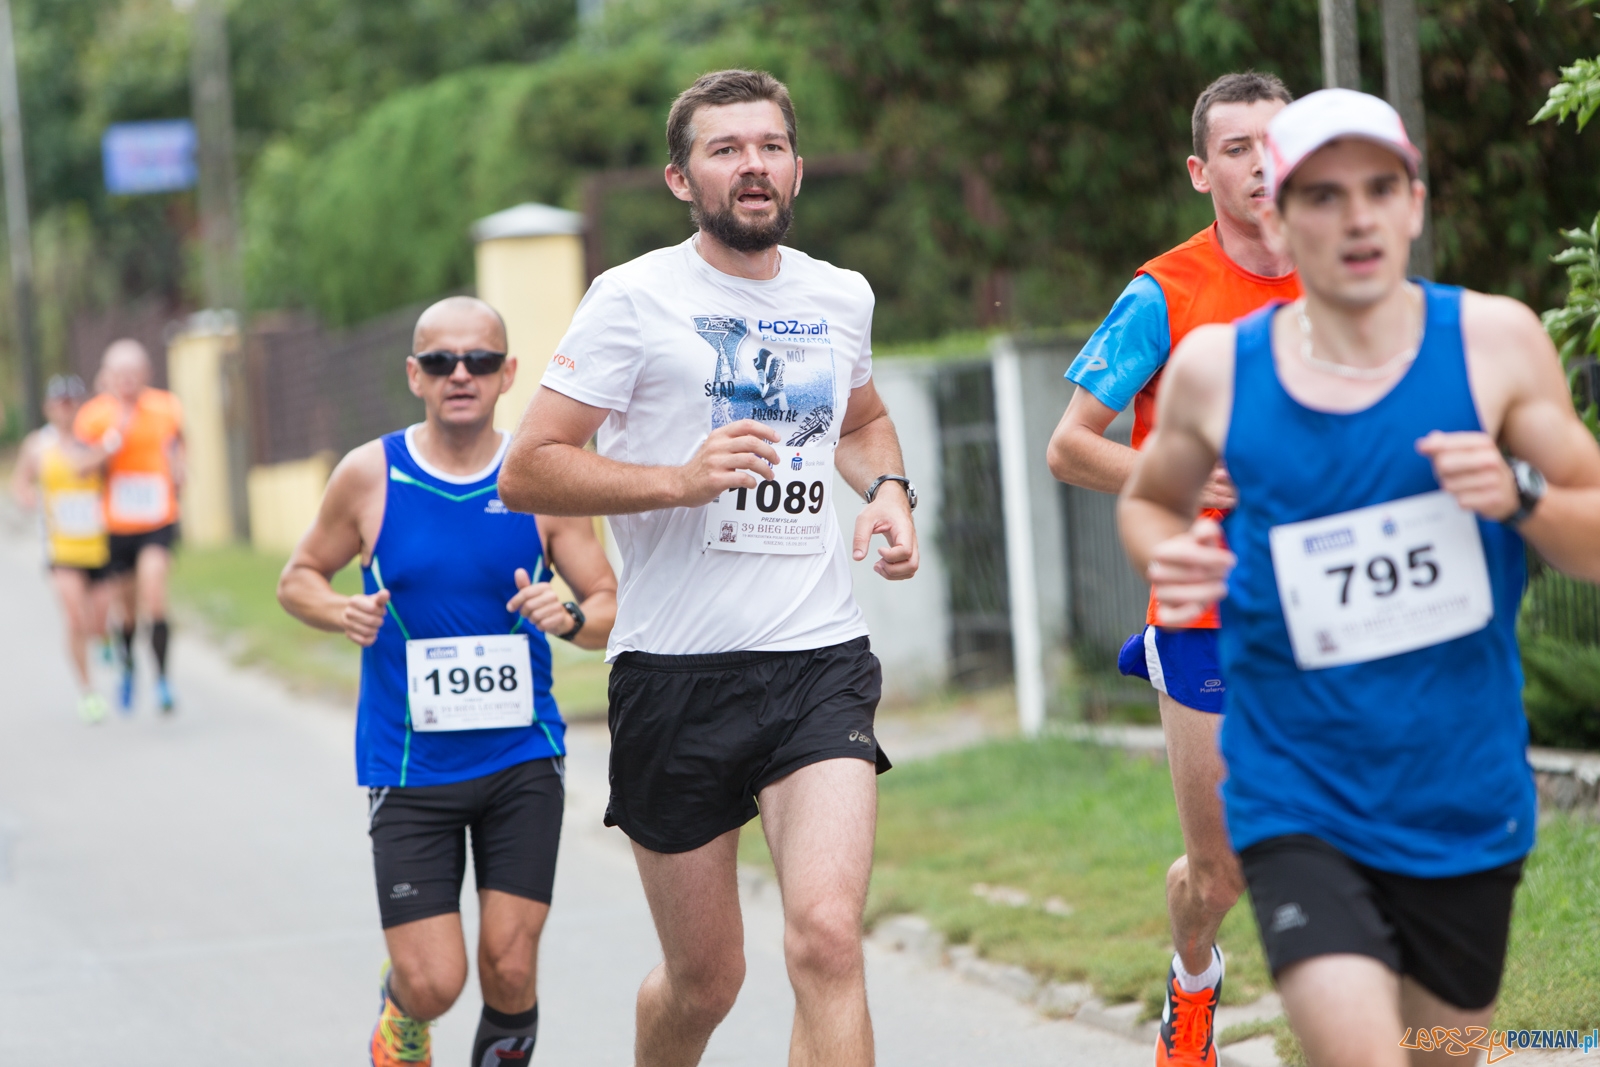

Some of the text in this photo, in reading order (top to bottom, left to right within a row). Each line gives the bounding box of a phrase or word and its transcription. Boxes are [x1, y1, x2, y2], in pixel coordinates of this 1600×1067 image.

[786, 347, 805, 363] MÓJ
[751, 408, 799, 423] POZOSTAŁ
[728, 479, 825, 514] 1089
[741, 522, 822, 535] 39 BIEG LECHITÓW
[1325, 544, 1440, 605] 795
[425, 664, 518, 696] 1968
